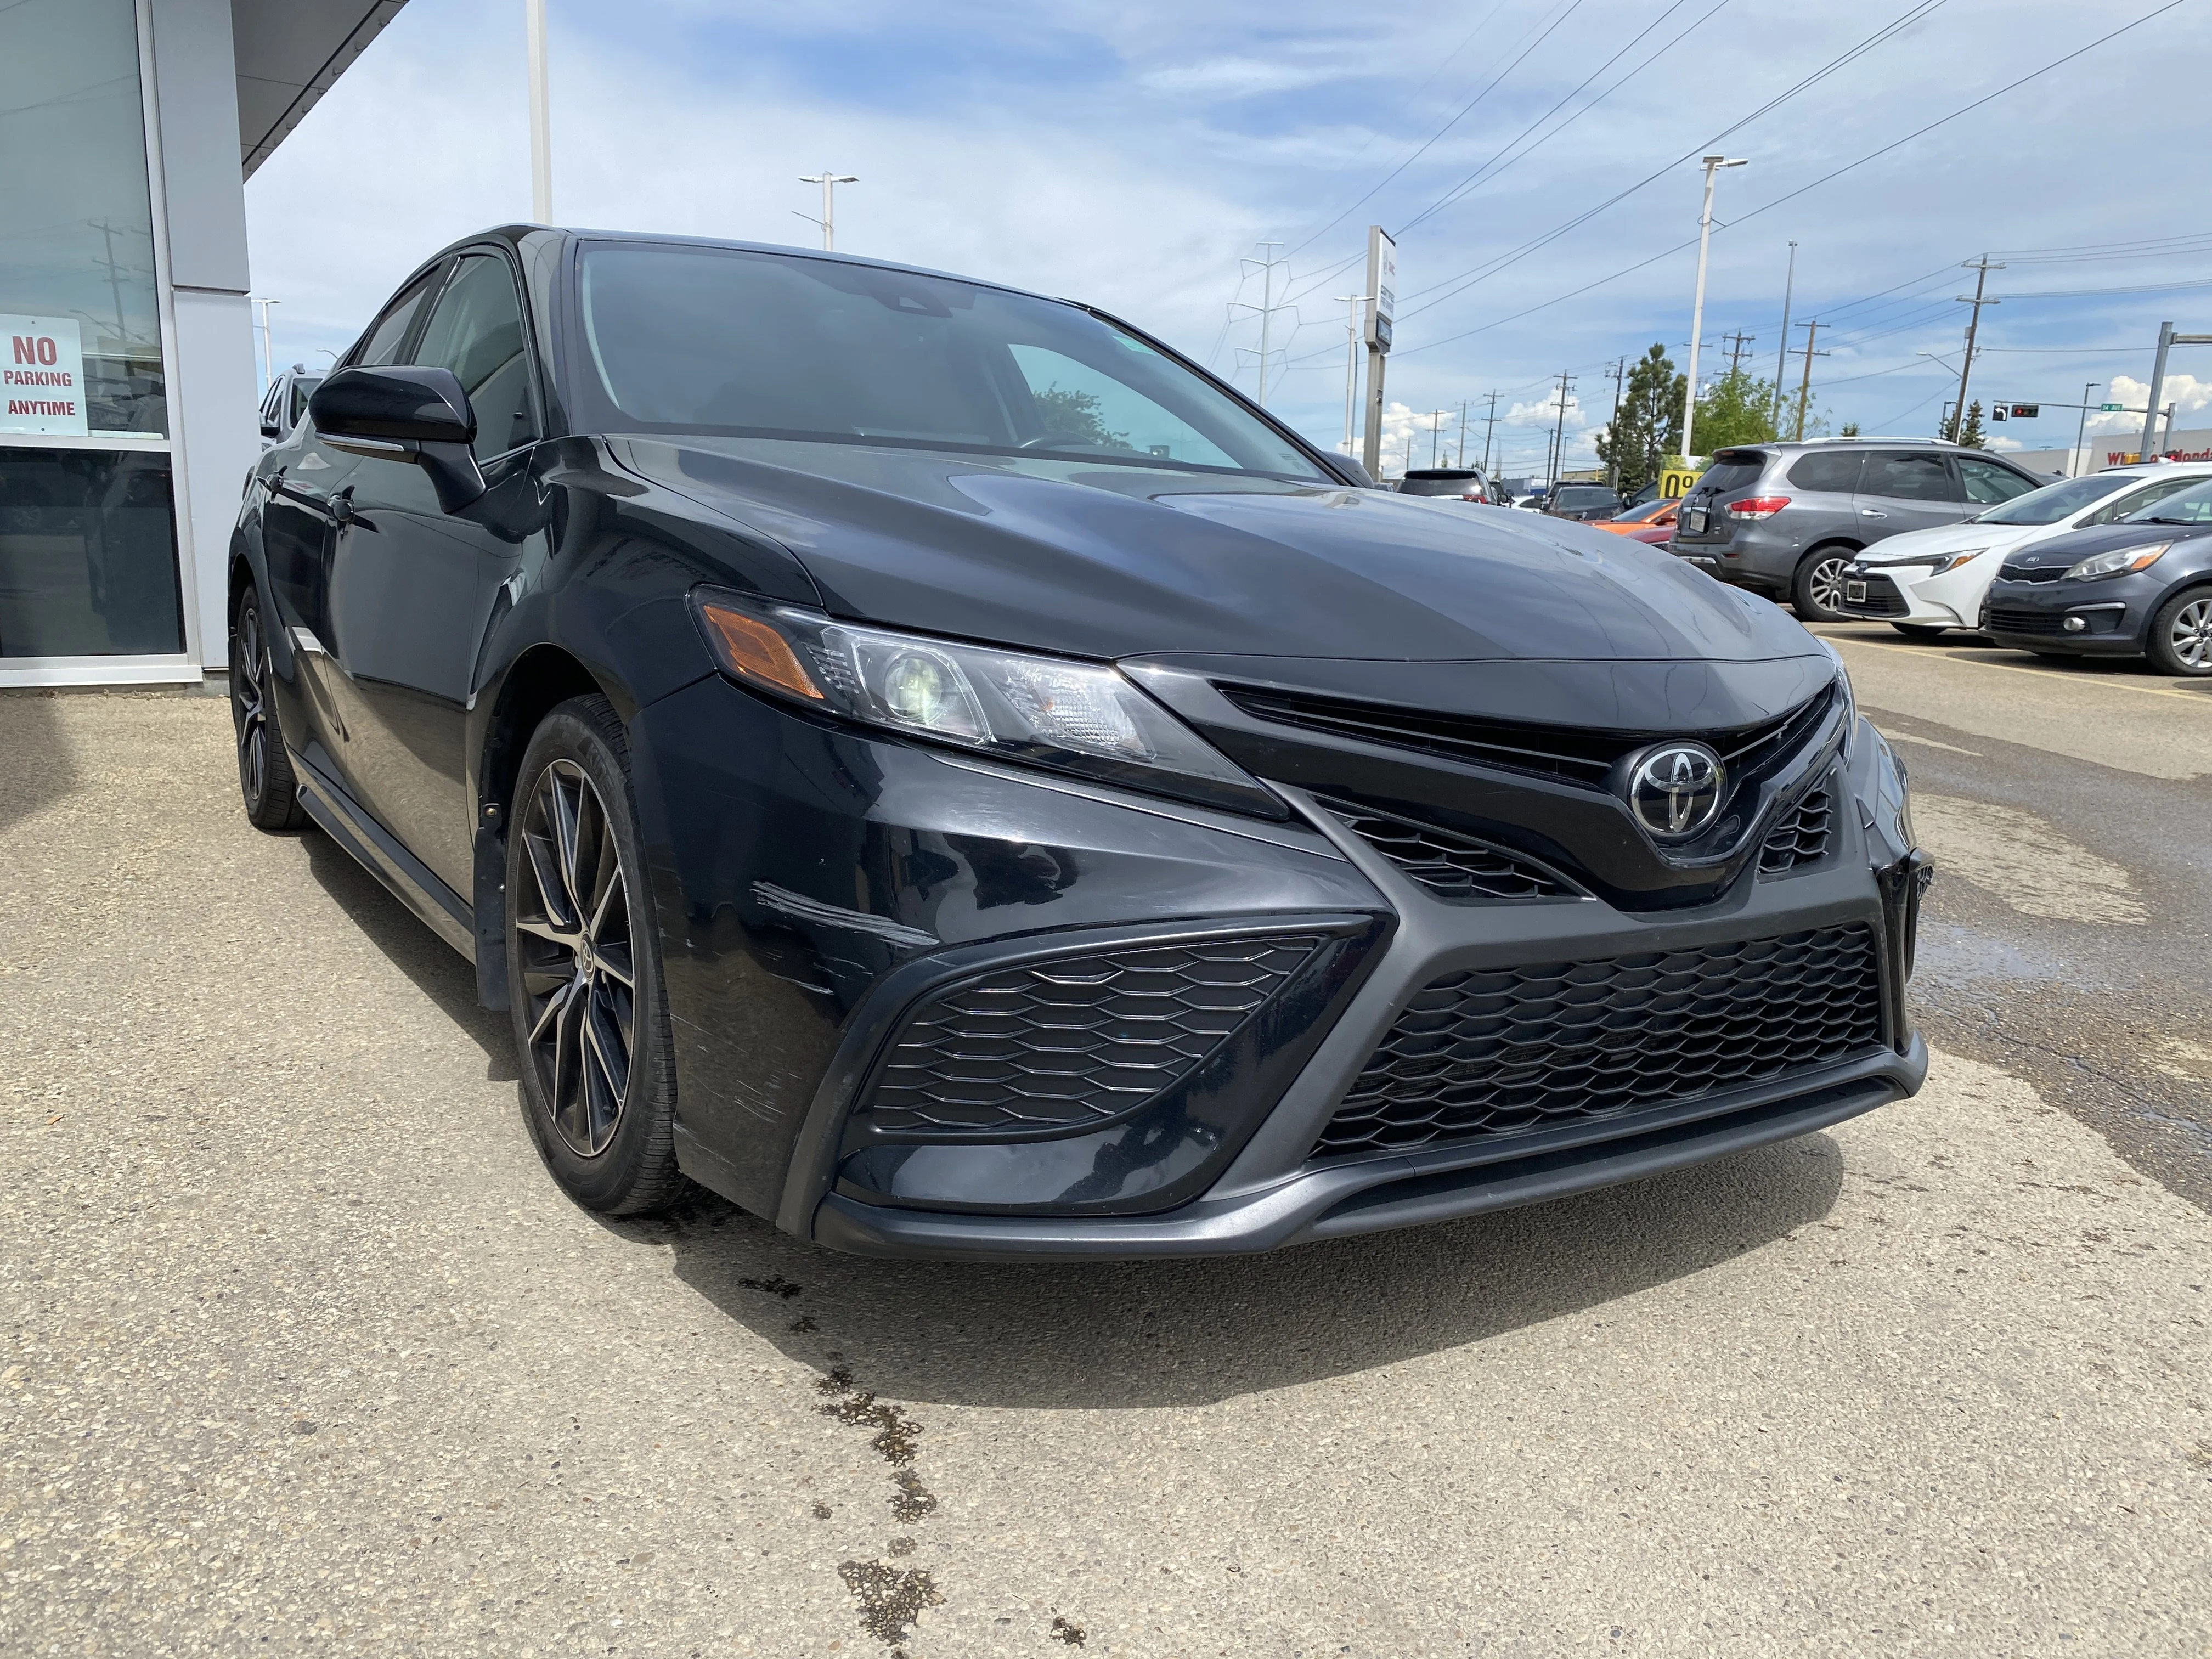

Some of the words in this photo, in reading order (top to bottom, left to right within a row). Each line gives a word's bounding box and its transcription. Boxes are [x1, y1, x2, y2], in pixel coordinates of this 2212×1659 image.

[12, 336, 57, 366] NO
[3, 370, 72, 387] PARKING
[8, 400, 76, 416] ANYTIME
